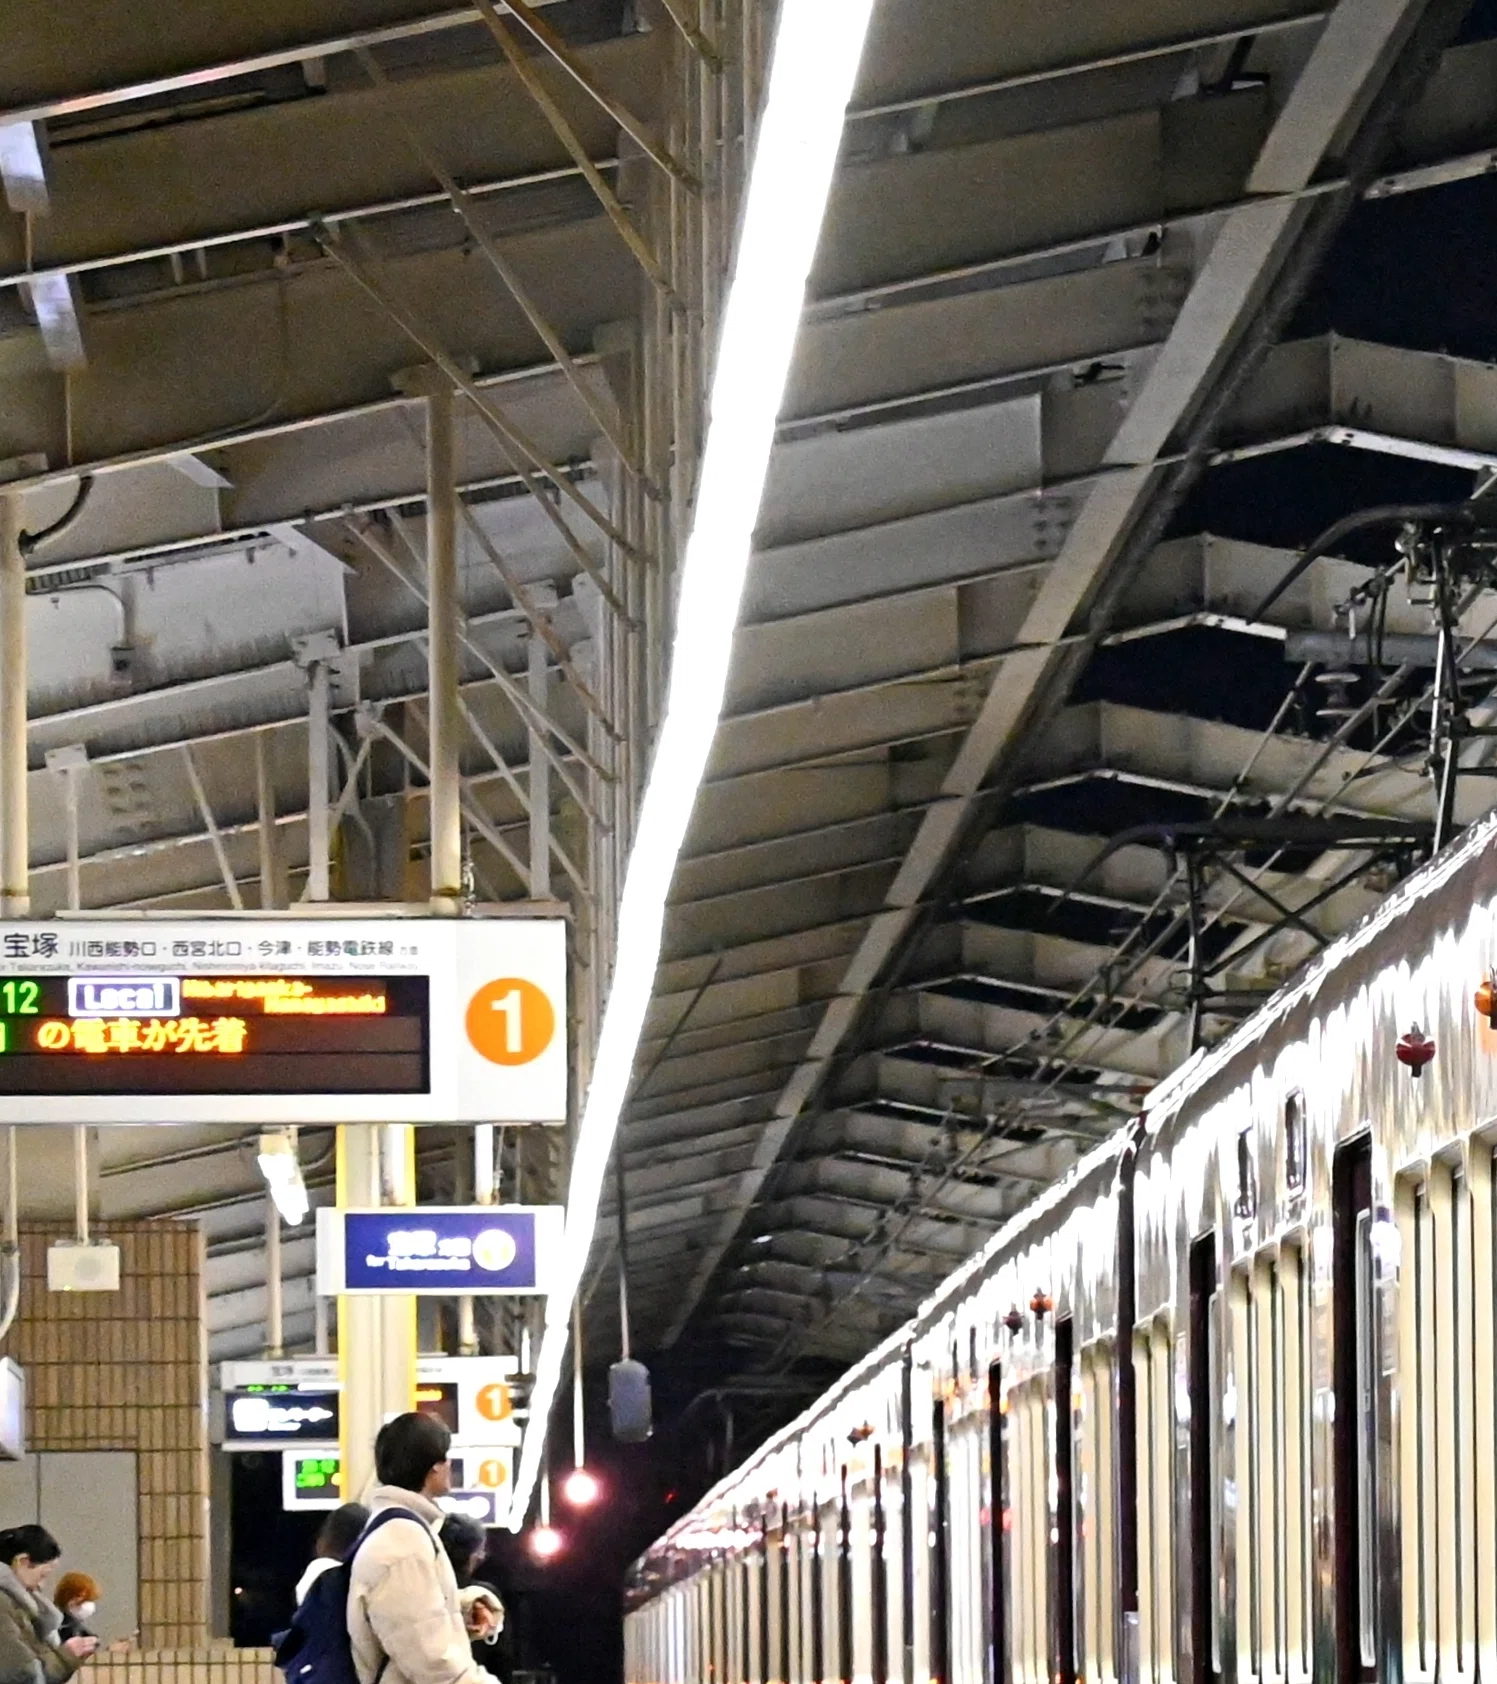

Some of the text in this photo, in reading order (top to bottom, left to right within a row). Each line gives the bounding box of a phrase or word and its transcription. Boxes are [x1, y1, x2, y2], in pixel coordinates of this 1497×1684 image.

[3, 932, 59, 958] 宝塚
[2, 981, 39, 1014] 12
[84, 983, 164, 1010] Local
[491, 990, 522, 1053] 1
[486, 1387, 502, 1416] 1
[486, 1462, 498, 1487] 1
